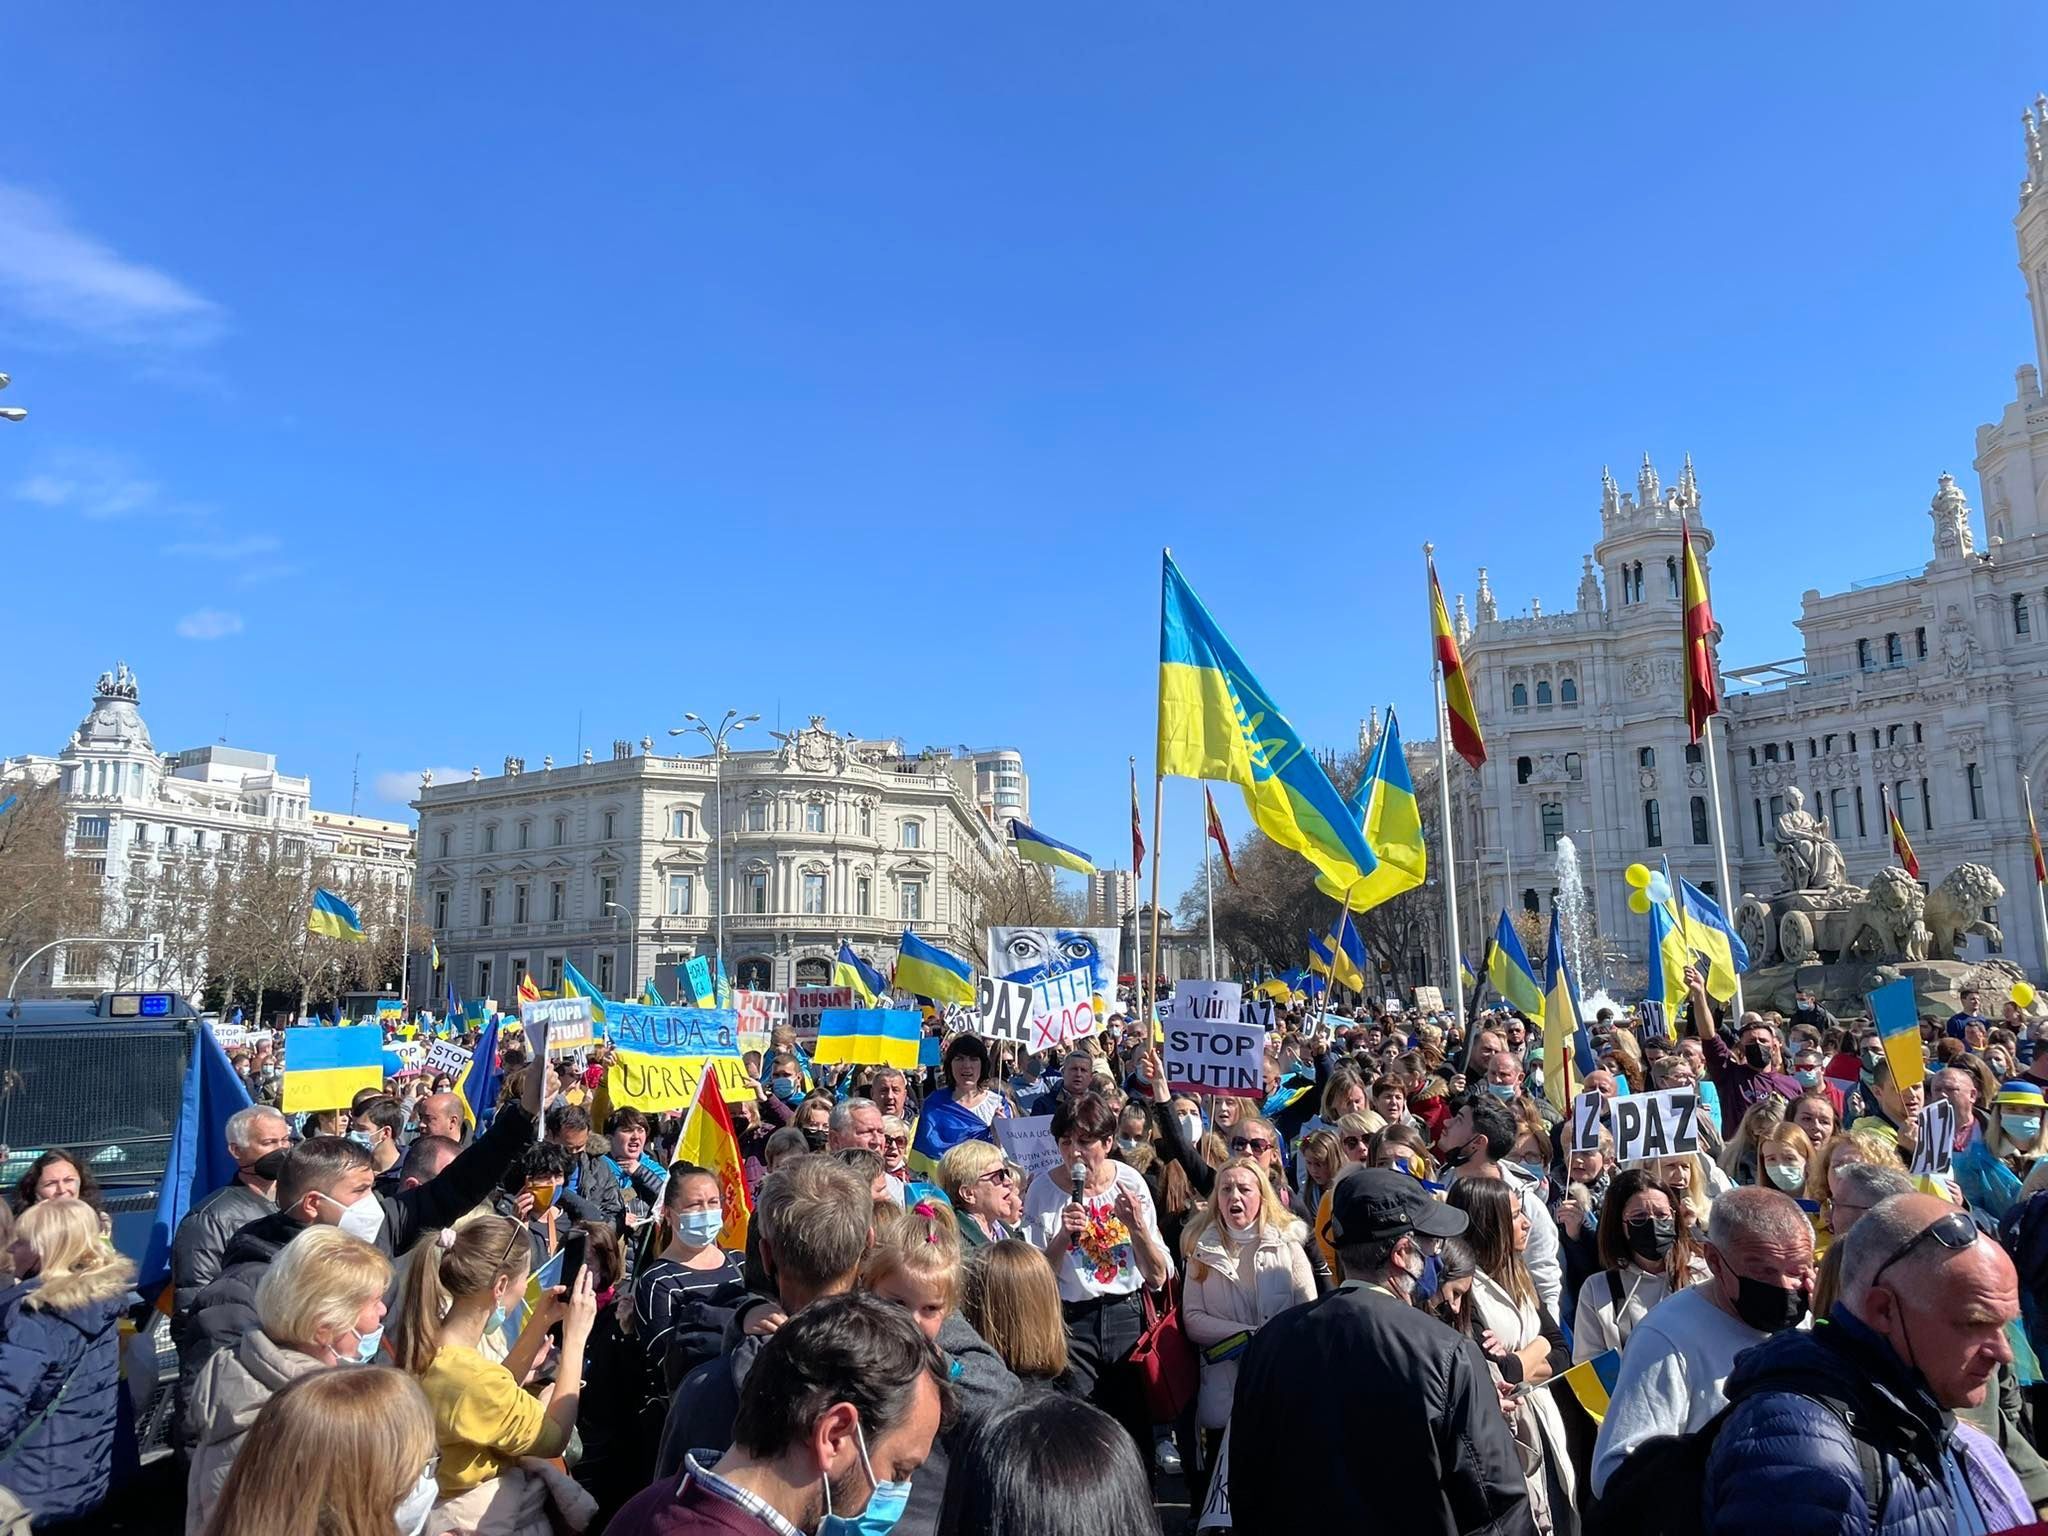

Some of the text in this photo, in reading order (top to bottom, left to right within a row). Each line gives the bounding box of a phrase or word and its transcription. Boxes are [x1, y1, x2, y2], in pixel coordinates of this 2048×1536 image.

[800, 994, 842, 1008] RUSIA
[979, 979, 1032, 1041] PAZ
[620, 1013, 707, 1047] AYUDA
[1170, 1031, 1255, 1056] STOP
[1167, 1061, 1258, 1089] PUTIN
[1617, 1095, 1698, 1160] PAZ
[1910, 1101, 1949, 1173] PAZ
